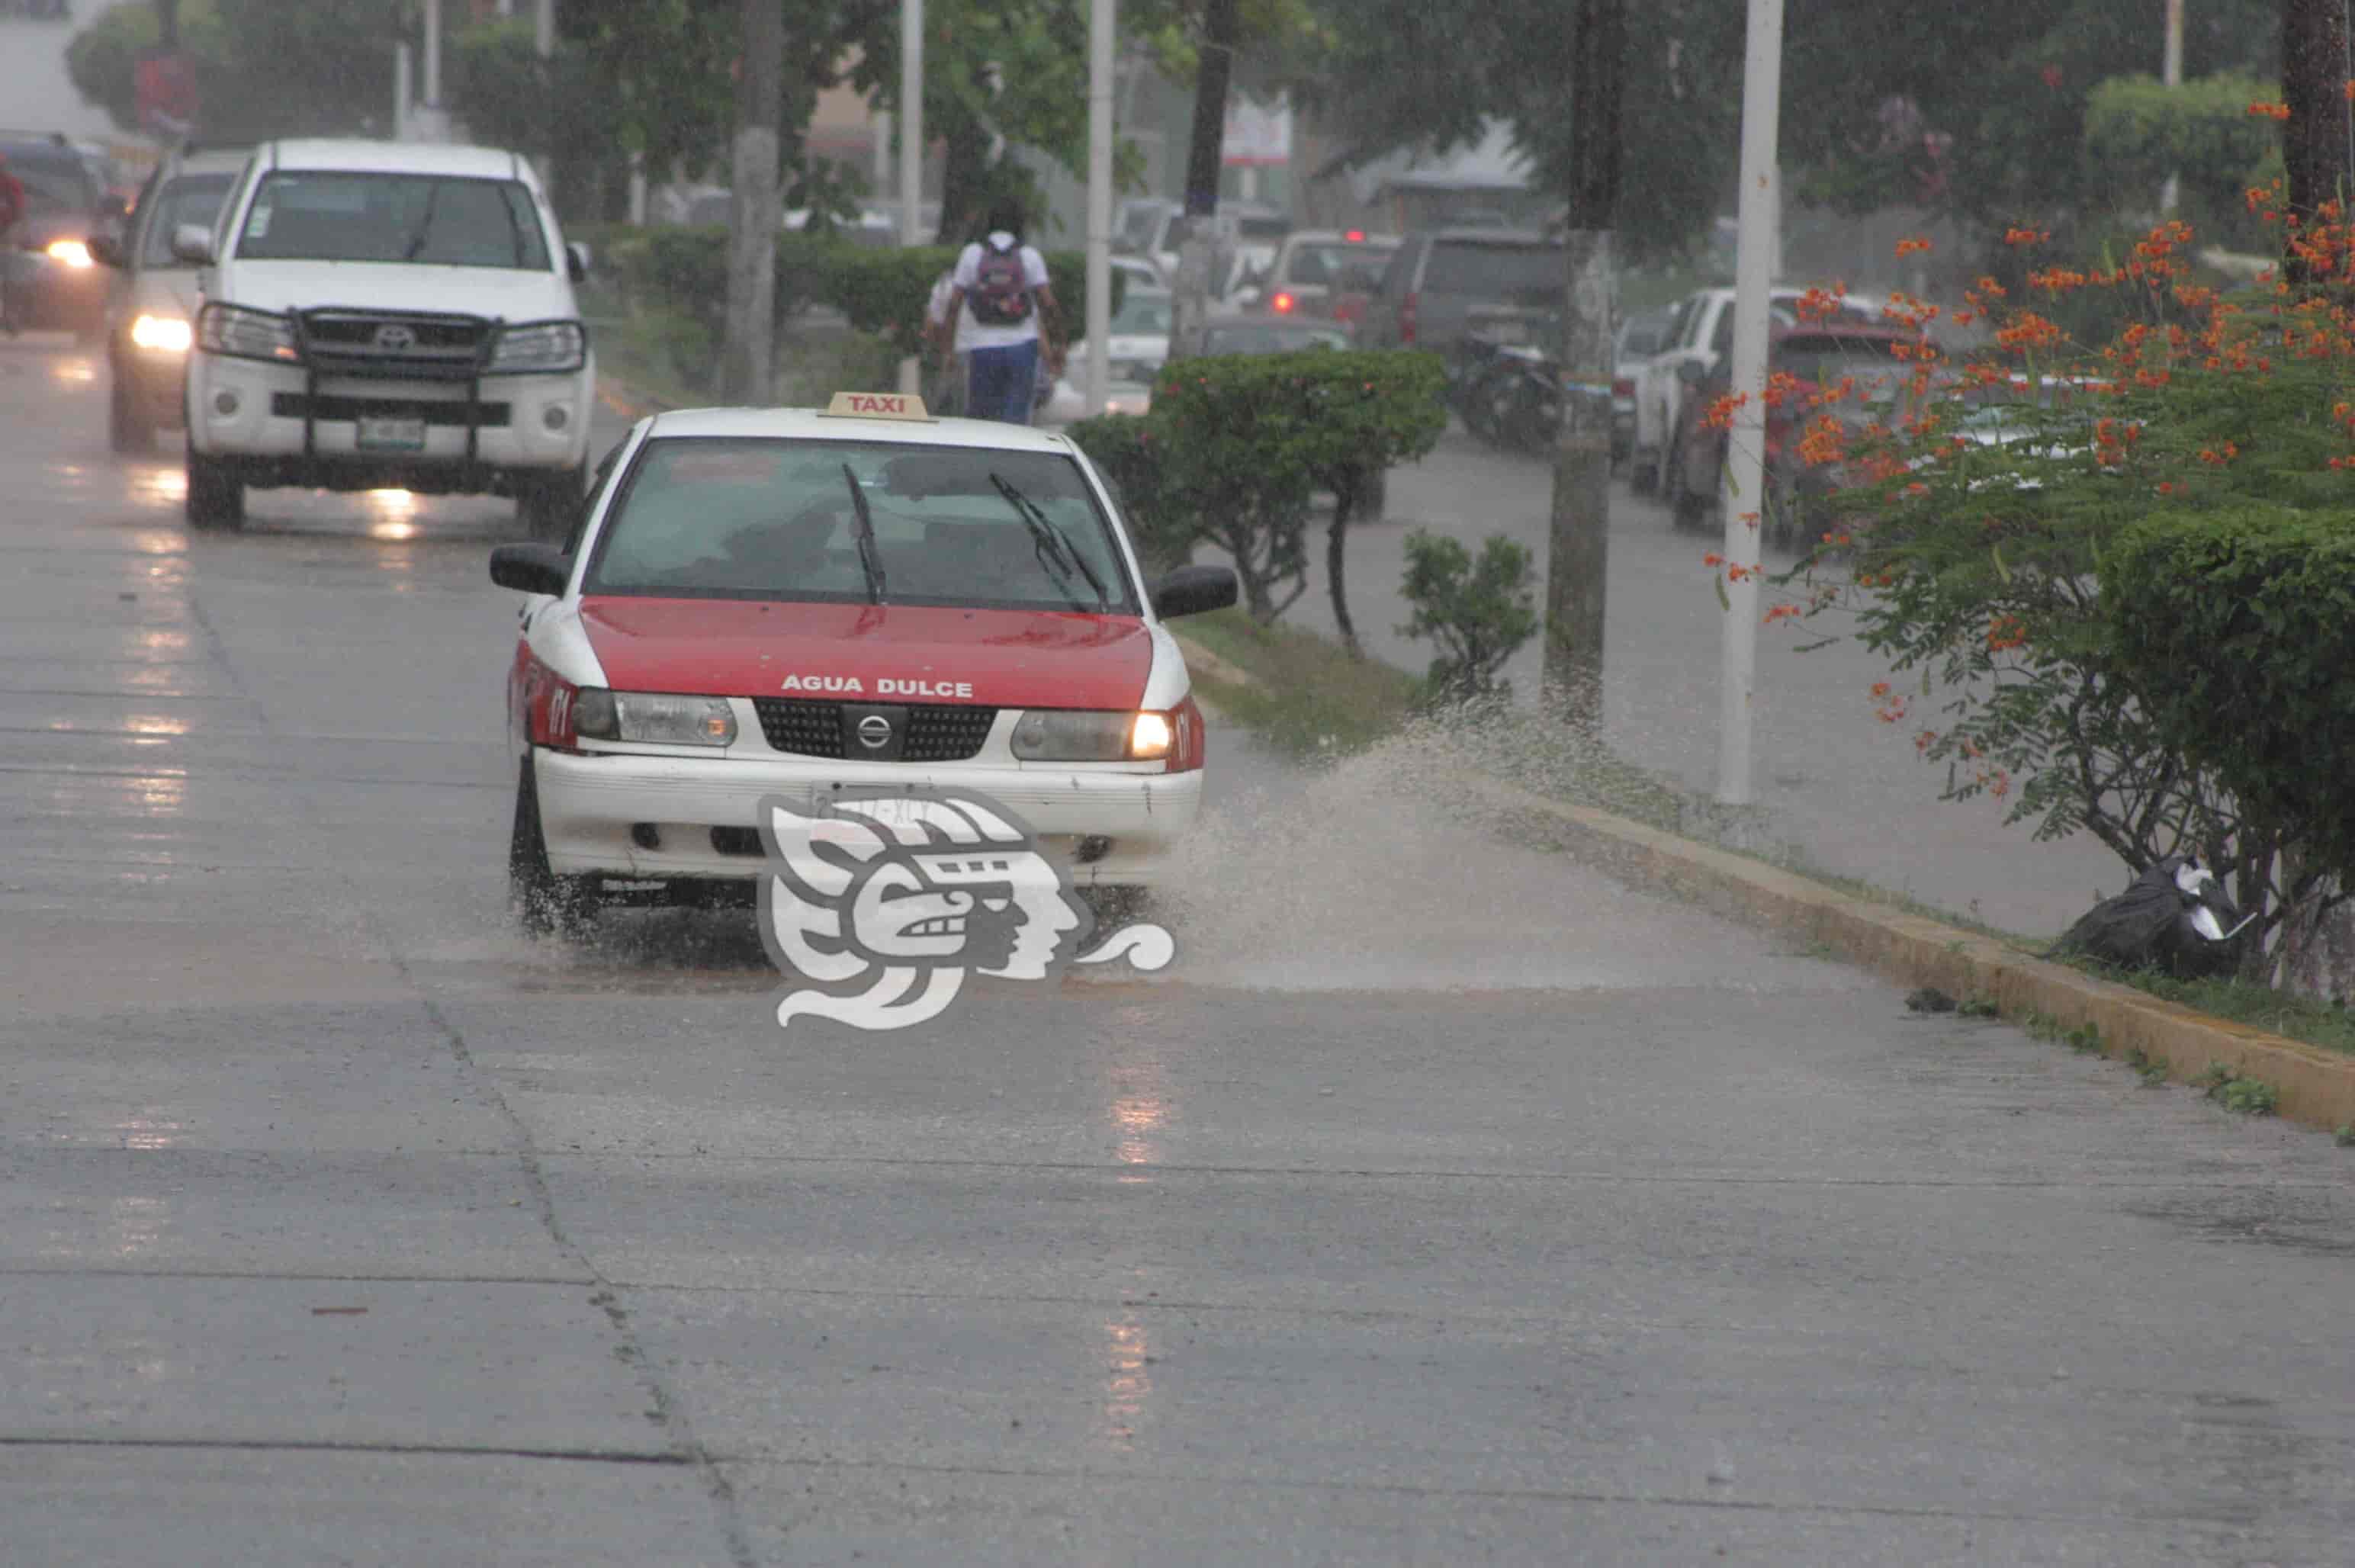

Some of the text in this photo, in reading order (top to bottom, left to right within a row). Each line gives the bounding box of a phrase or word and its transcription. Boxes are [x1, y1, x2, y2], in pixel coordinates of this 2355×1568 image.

[847, 395, 904, 413] TAXI
[780, 673, 973, 698] AGUA DULCE
